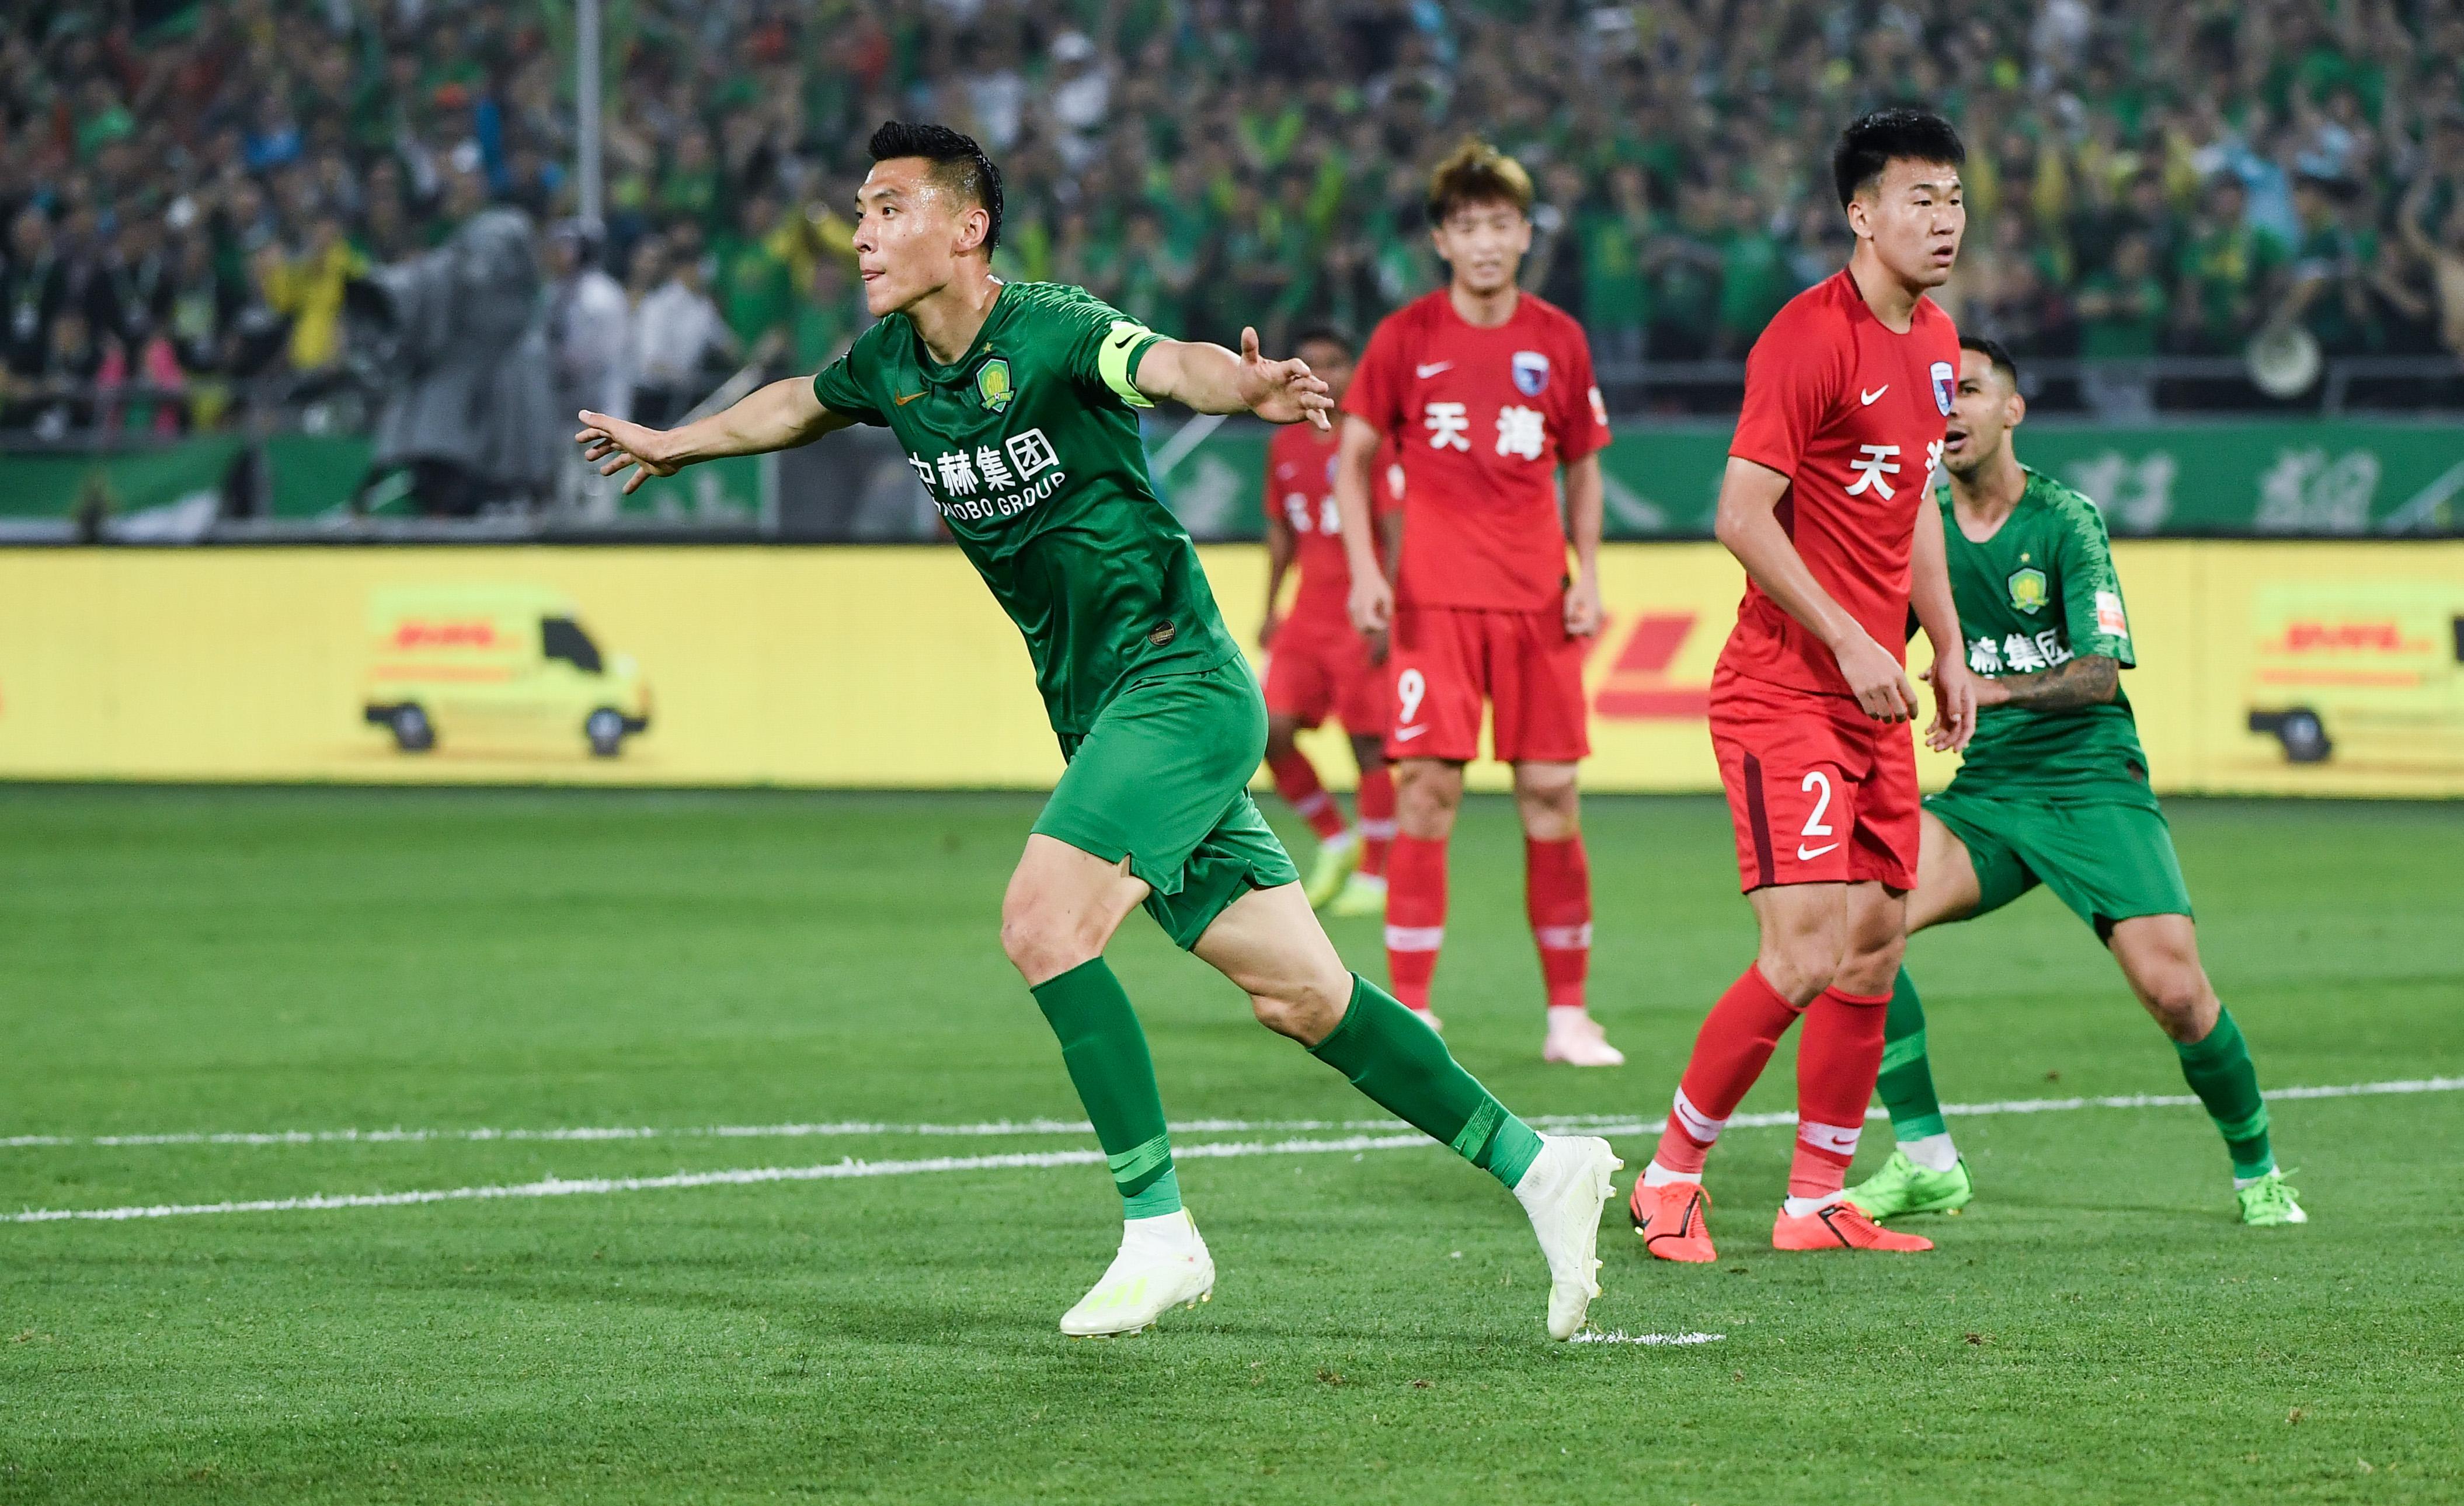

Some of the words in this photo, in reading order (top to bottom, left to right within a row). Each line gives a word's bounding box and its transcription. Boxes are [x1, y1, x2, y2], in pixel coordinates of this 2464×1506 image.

[1424, 402, 1546, 461] 天海
[997, 472, 1066, 516] GROUP
[1397, 668, 1425, 724] 9
[1800, 771, 1833, 836] 2
